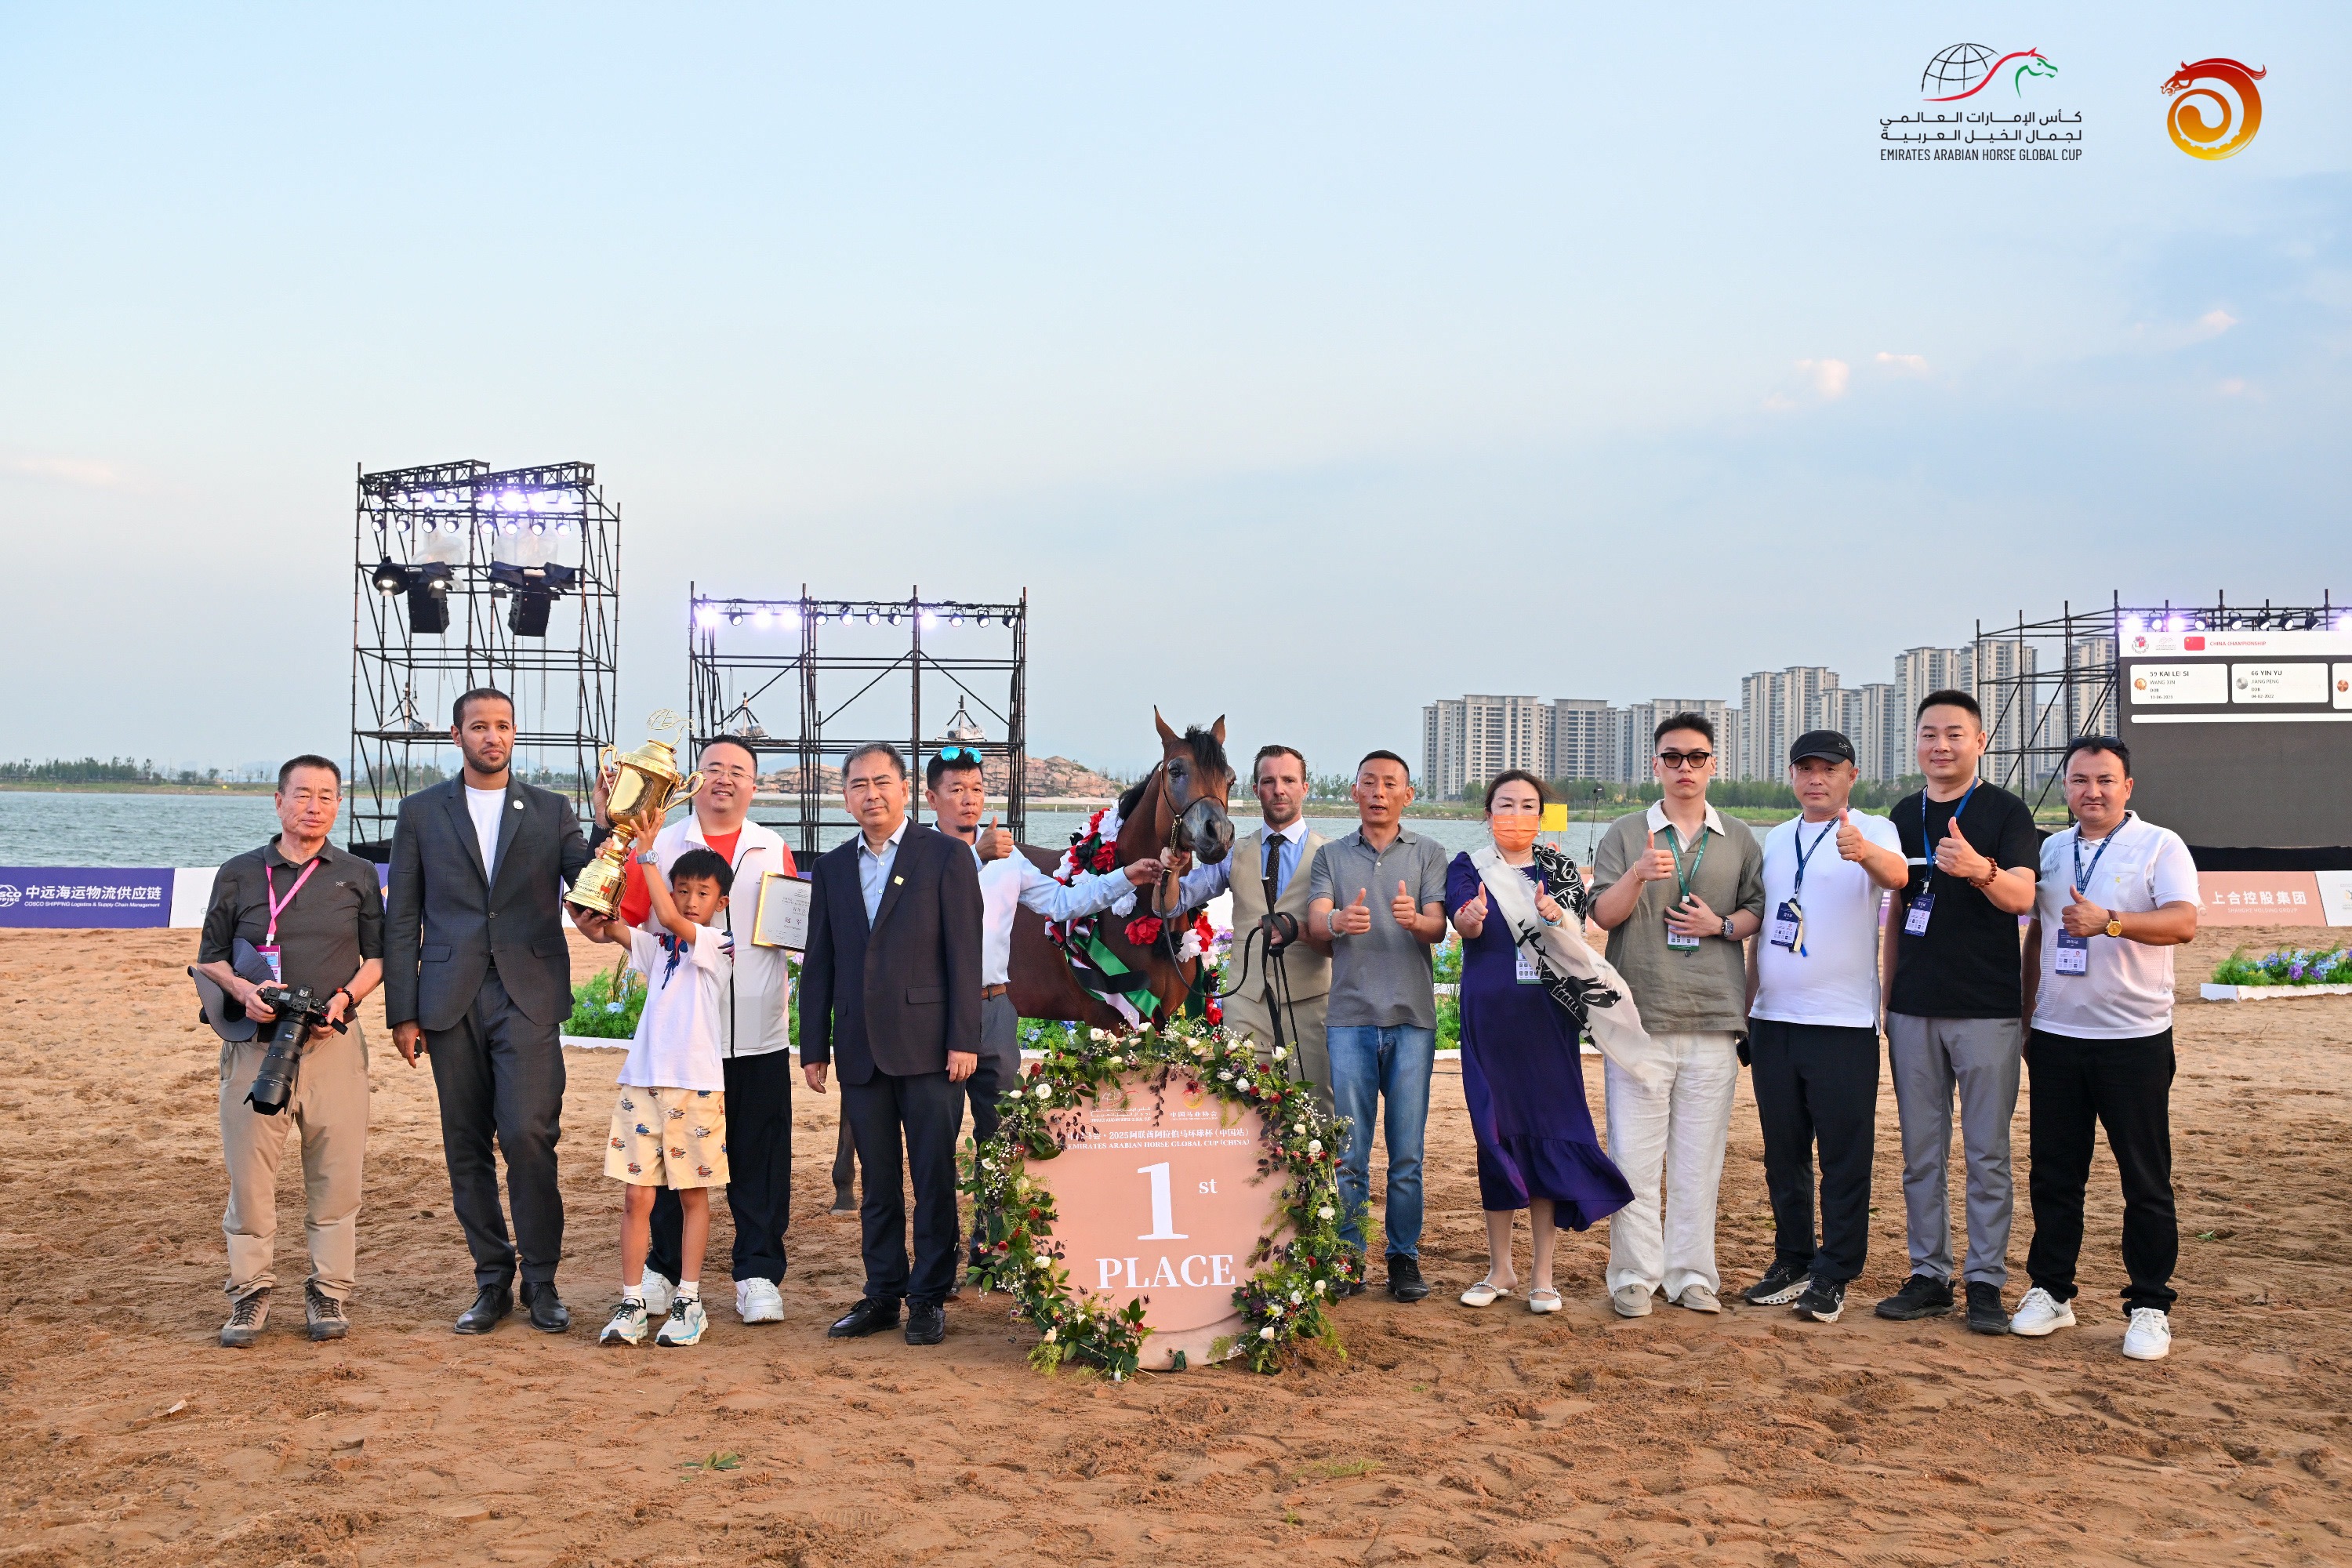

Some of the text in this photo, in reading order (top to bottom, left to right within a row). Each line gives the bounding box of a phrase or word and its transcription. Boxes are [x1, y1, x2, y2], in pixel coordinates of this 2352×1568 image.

[25, 884, 162, 900] 中远海运物流供应链
[2212, 891, 2307, 905] 上合控股集团
[1137, 1162, 1218, 1240] 1 st
[1095, 1254, 1236, 1289] PLACE
